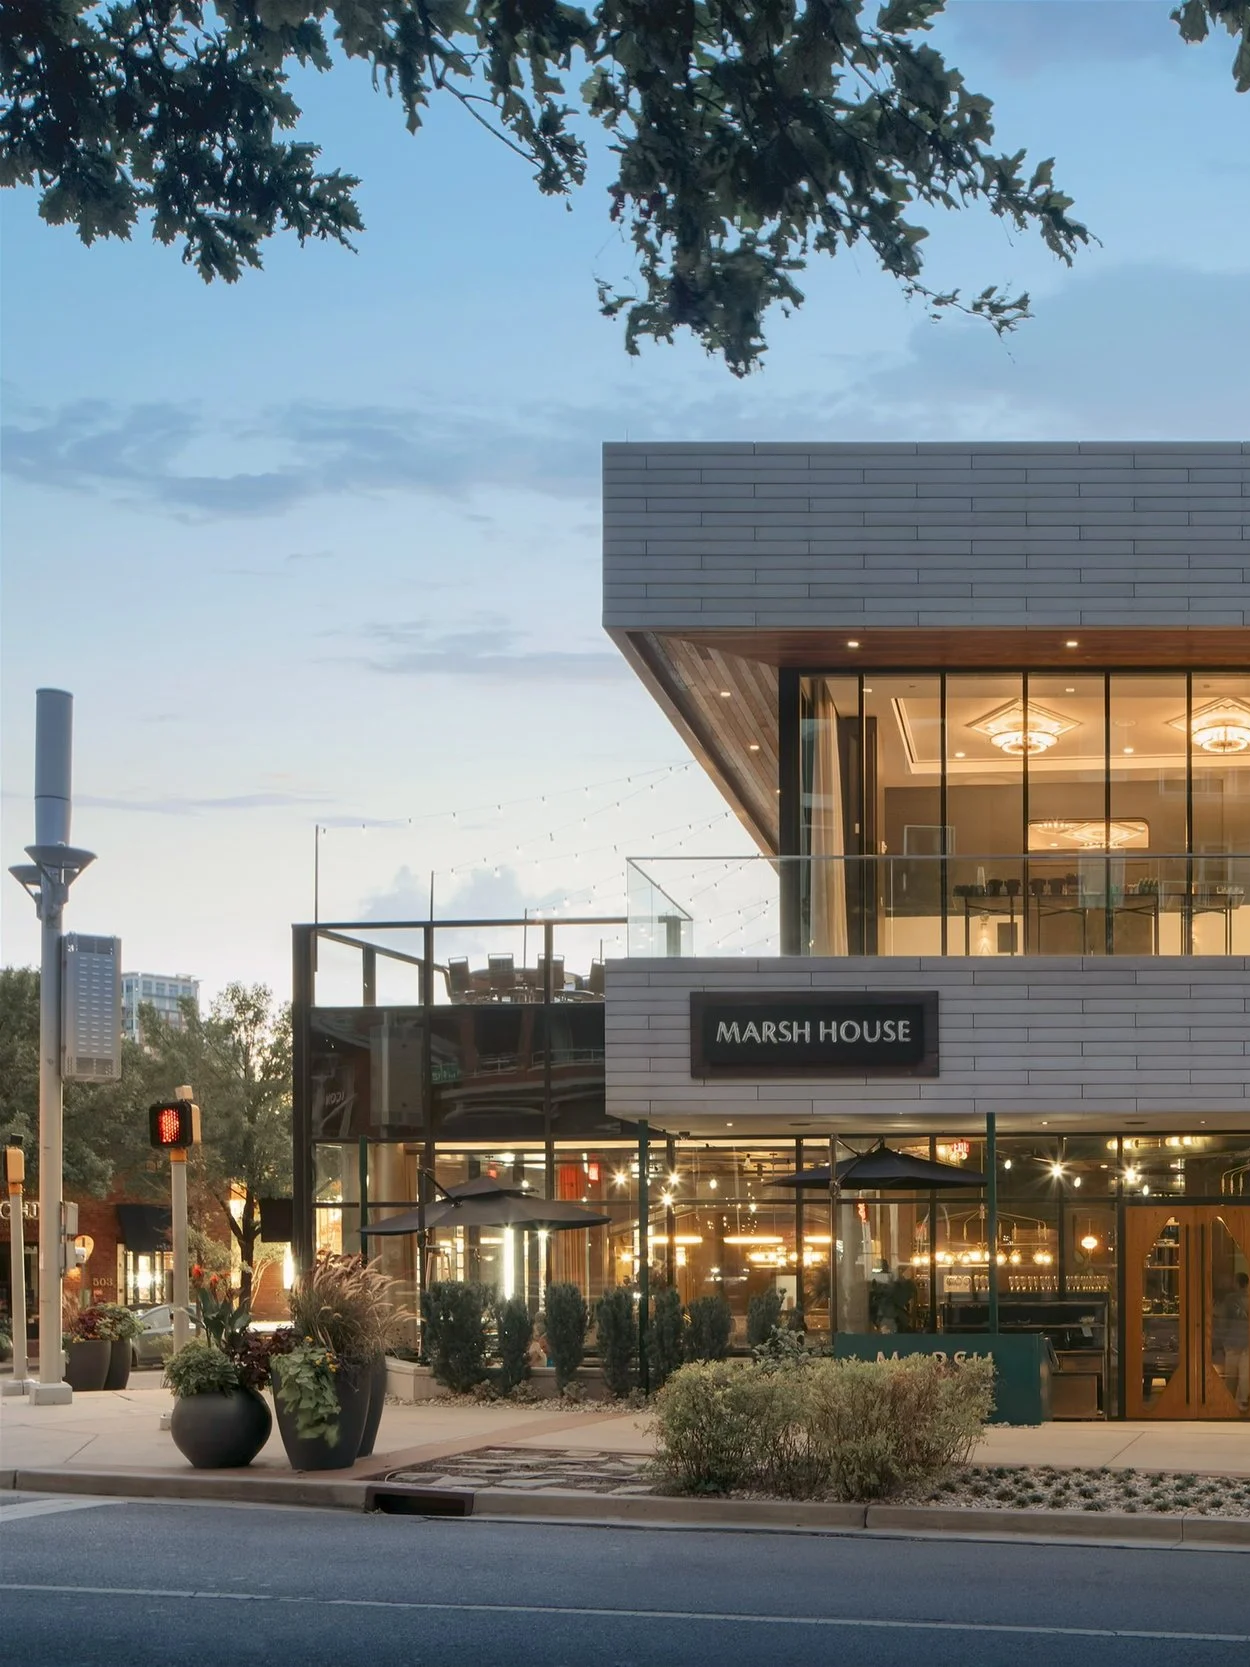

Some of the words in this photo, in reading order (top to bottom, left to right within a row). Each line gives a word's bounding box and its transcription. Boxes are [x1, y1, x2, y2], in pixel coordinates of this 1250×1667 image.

[716, 1020, 810, 1043] MARSH
[819, 1020, 912, 1043] HOUSE
[93, 1277, 113, 1287] 503
